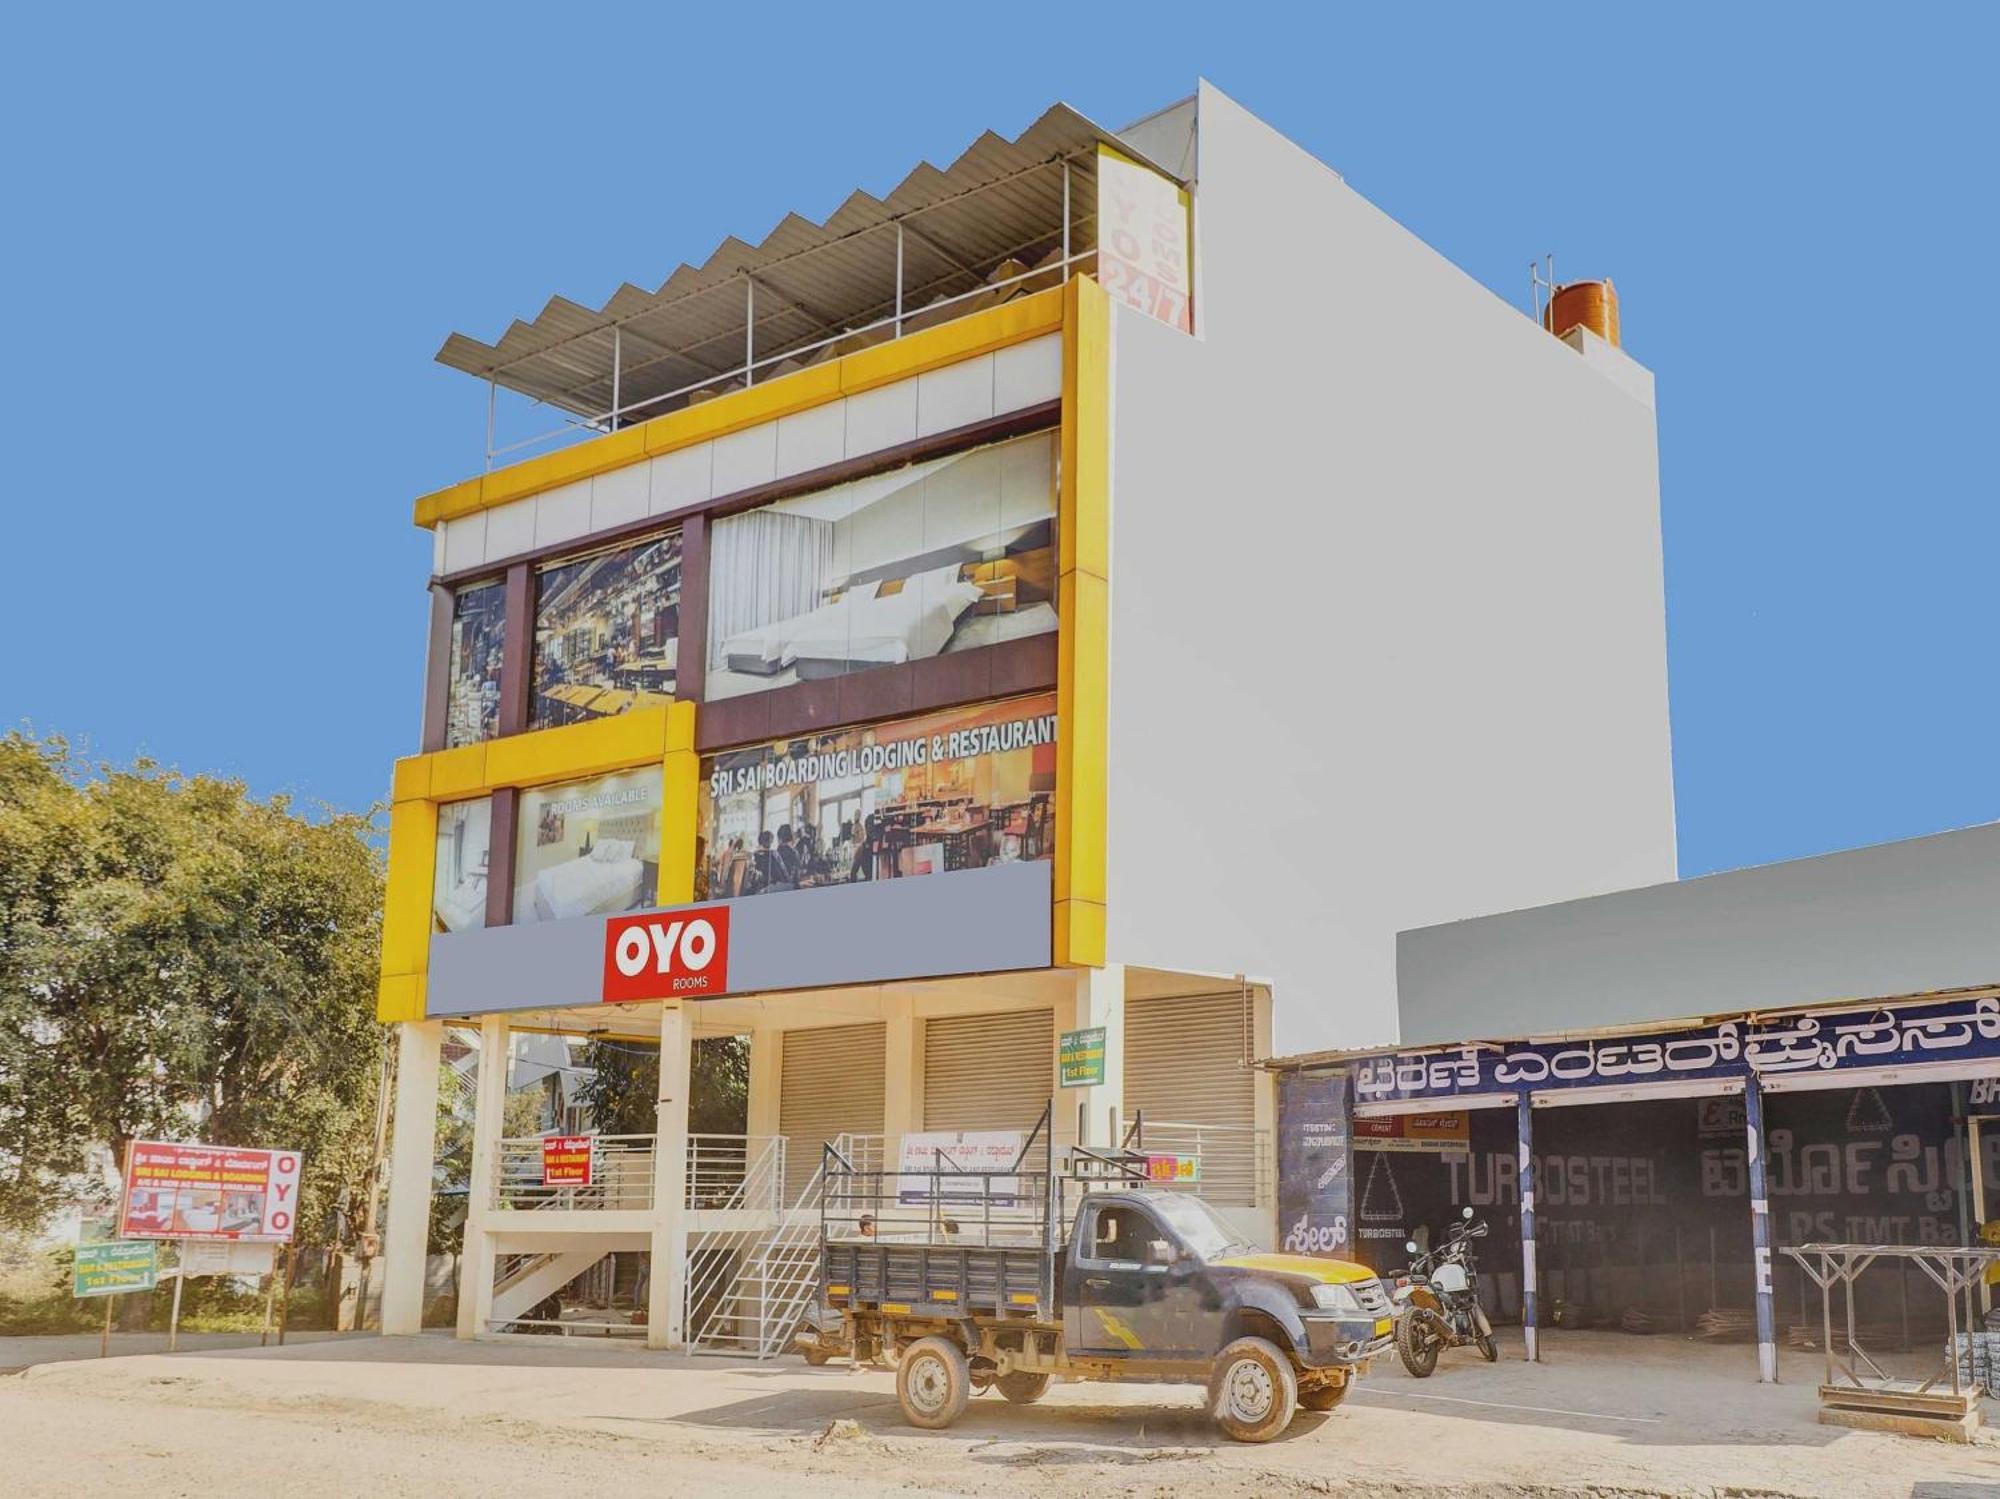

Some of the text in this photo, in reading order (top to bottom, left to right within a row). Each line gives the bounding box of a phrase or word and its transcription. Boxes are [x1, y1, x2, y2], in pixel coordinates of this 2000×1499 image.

[1104, 258, 1185, 325] 24/7
[710, 715, 1058, 798] SRI SAI BOARDING LODGING & RESTAURANT
[551, 786, 648, 816] ROOMS AVAILABLE
[615, 919, 716, 977] OYO
[673, 976, 708, 990] ROOMS
[271, 1156, 296, 1230] OYO
[1359, 1227, 1406, 1239] TURBOSTEEL
